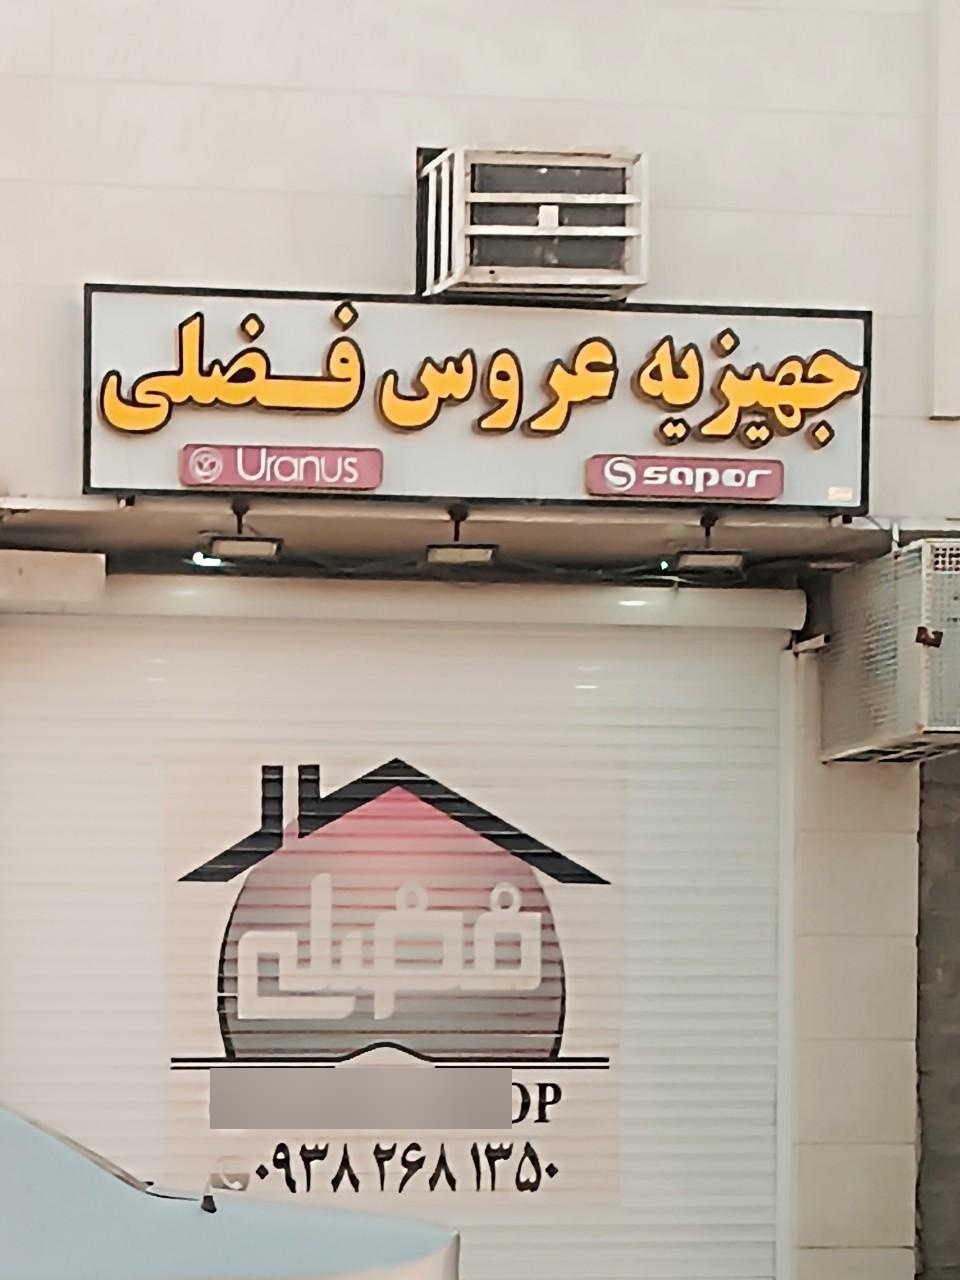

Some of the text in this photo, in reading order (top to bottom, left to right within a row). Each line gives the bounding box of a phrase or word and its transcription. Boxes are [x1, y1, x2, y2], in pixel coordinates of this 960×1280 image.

[100, 300, 865, 450] جهیزیه عروس فضلی
[236, 447, 360, 483] Uranus
[642, 465, 773, 493] sapor
[237, 872, 542, 1020] فضلی
